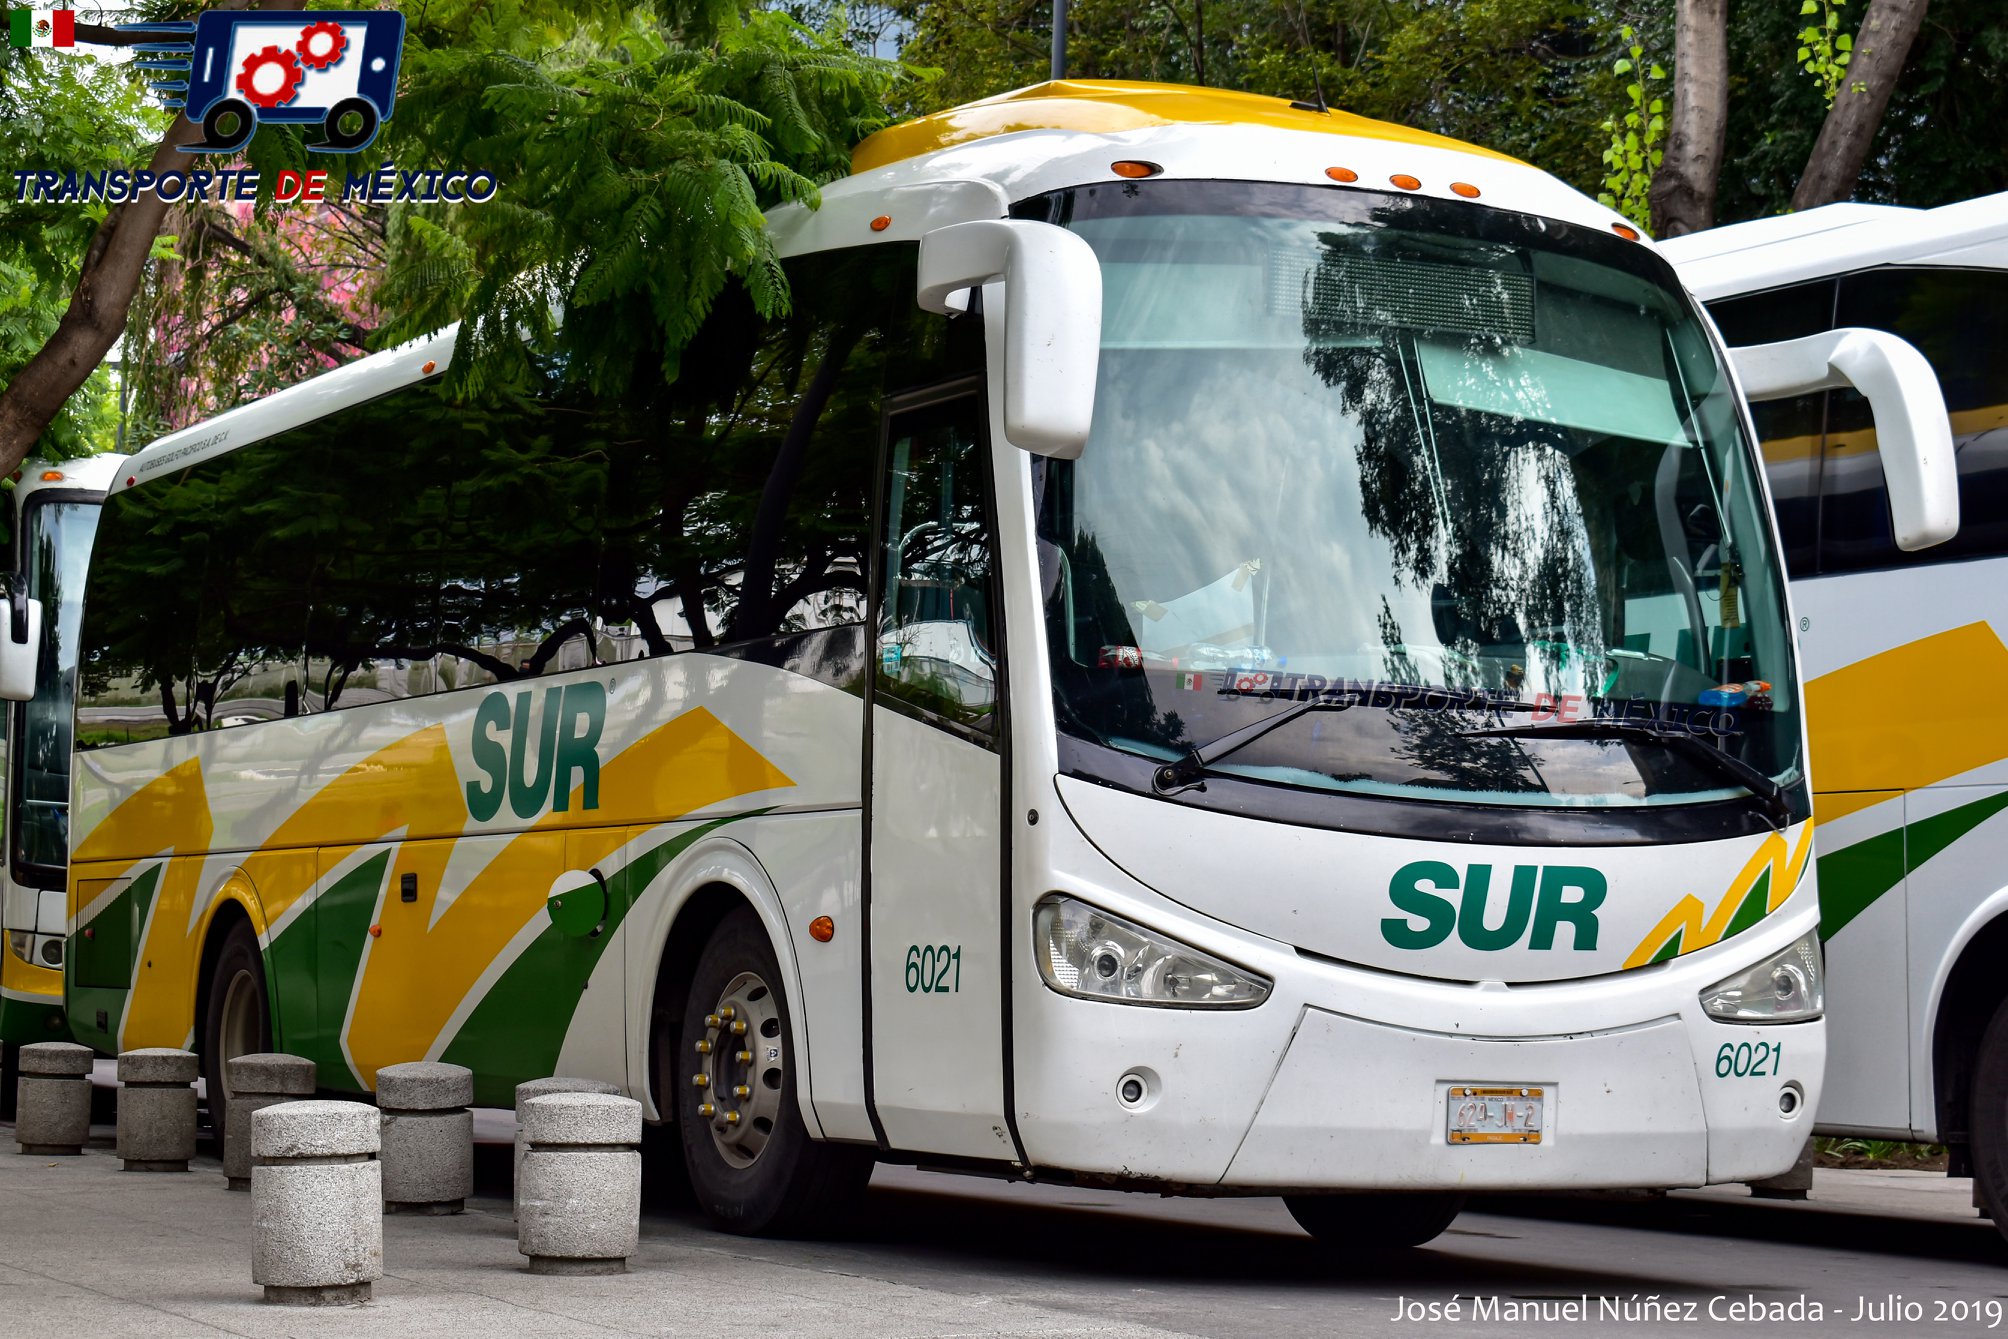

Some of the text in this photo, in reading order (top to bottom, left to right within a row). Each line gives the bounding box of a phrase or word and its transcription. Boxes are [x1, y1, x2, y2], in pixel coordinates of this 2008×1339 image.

[466, 681, 607, 822] SUR
[1380, 860, 1608, 951] SUR
[905, 944, 961, 993] 6021
[1715, 1041, 1781, 1078] 6021
